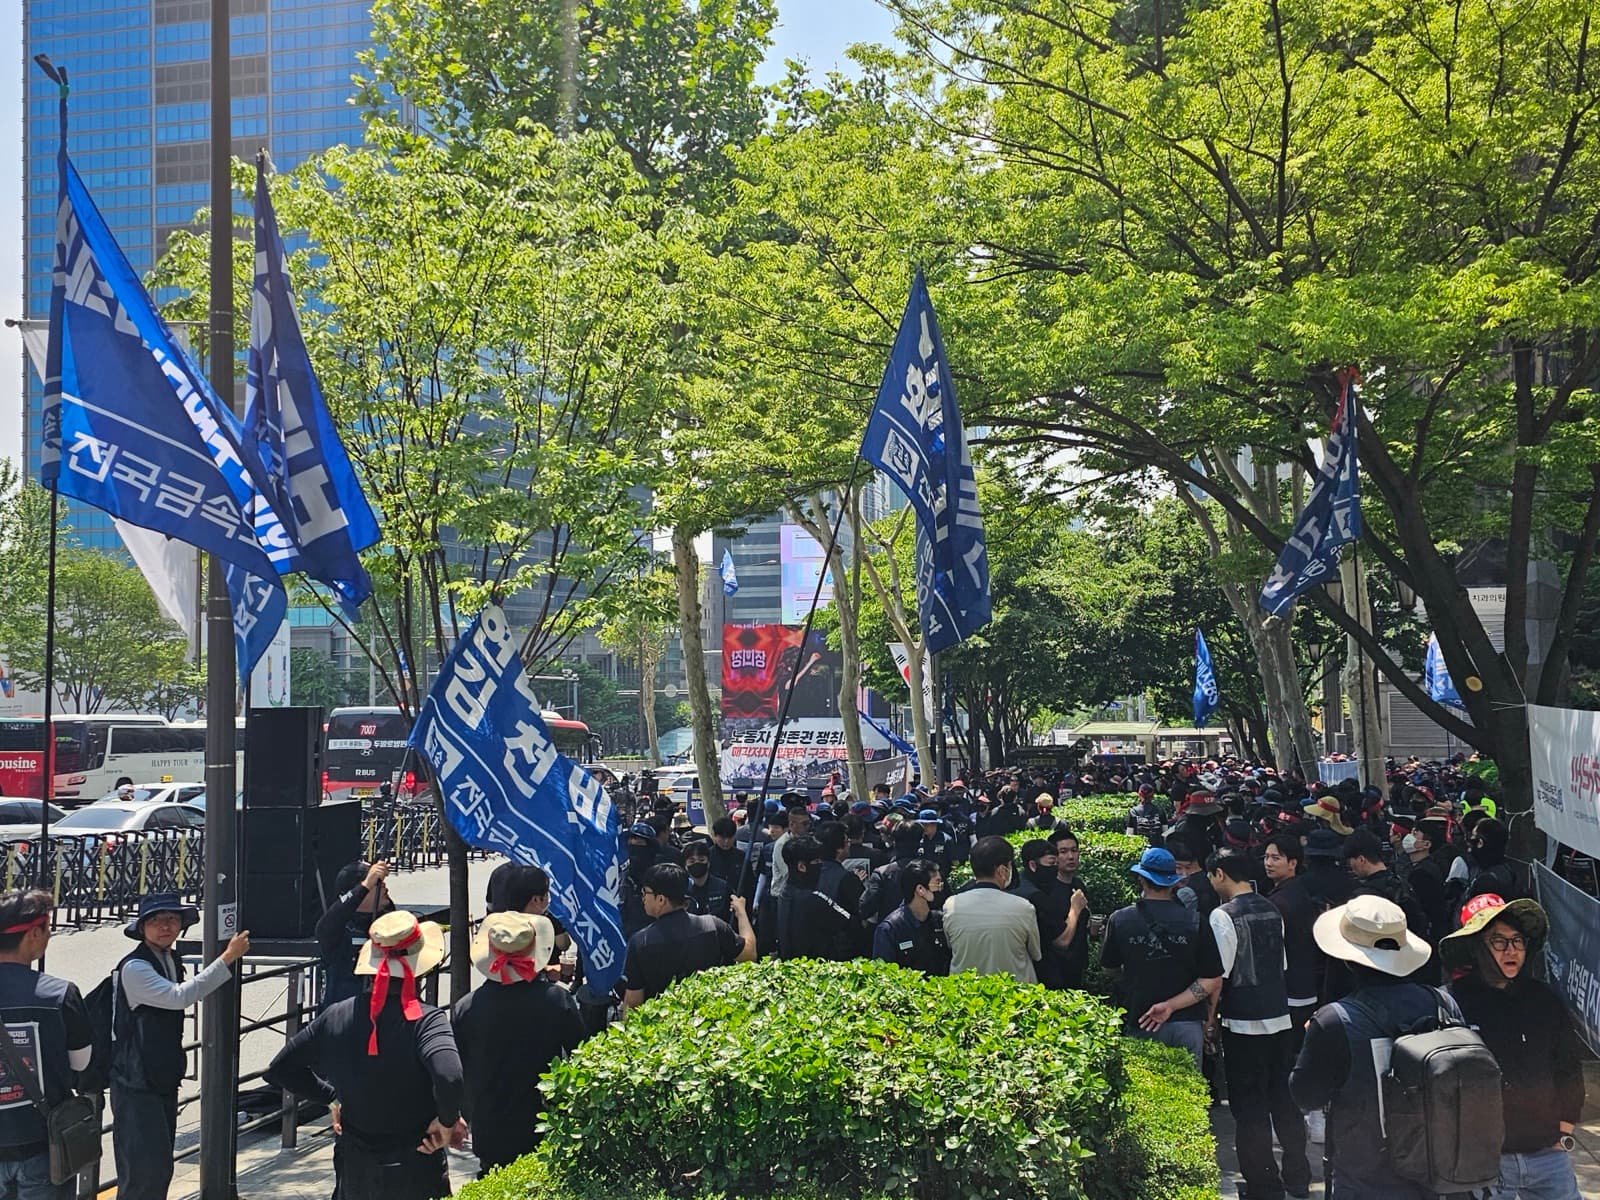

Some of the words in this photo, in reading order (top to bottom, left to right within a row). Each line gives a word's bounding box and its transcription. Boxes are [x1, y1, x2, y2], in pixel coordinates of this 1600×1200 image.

[360, 724, 377, 735] 7007
[731, 730, 773, 744] 노동자
[151, 759, 171, 768] HAPPY
[173, 758, 188, 767] TOUR
